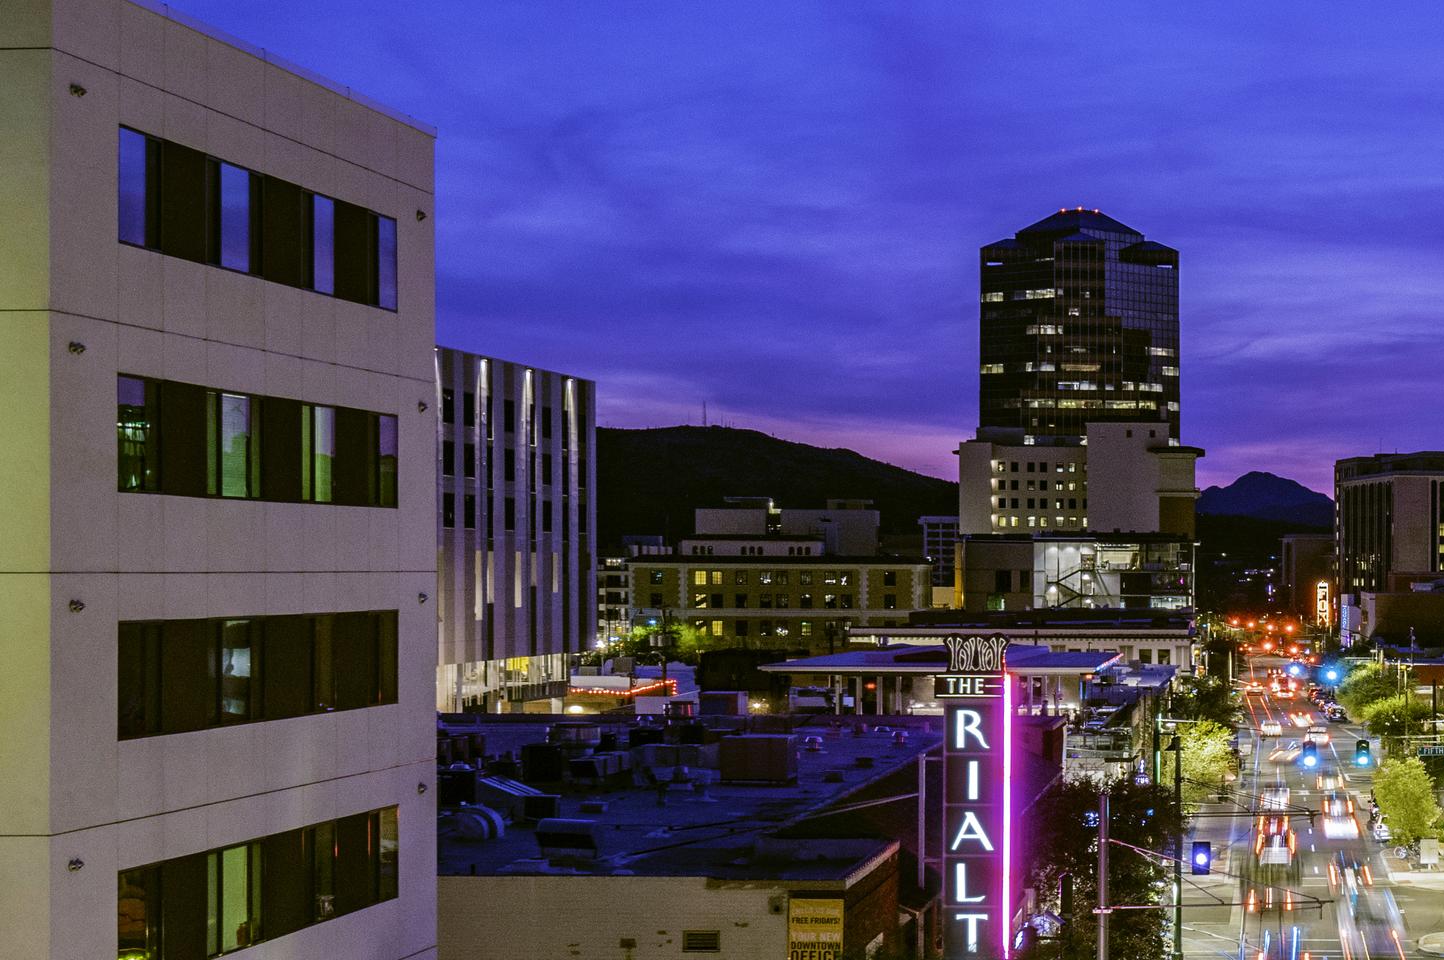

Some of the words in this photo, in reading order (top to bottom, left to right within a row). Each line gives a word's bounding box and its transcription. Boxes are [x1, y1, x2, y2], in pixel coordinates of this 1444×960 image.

[946, 678, 984, 694] THE
[792, 917, 808, 925] FREE
[820, 932, 840, 941] NEW
